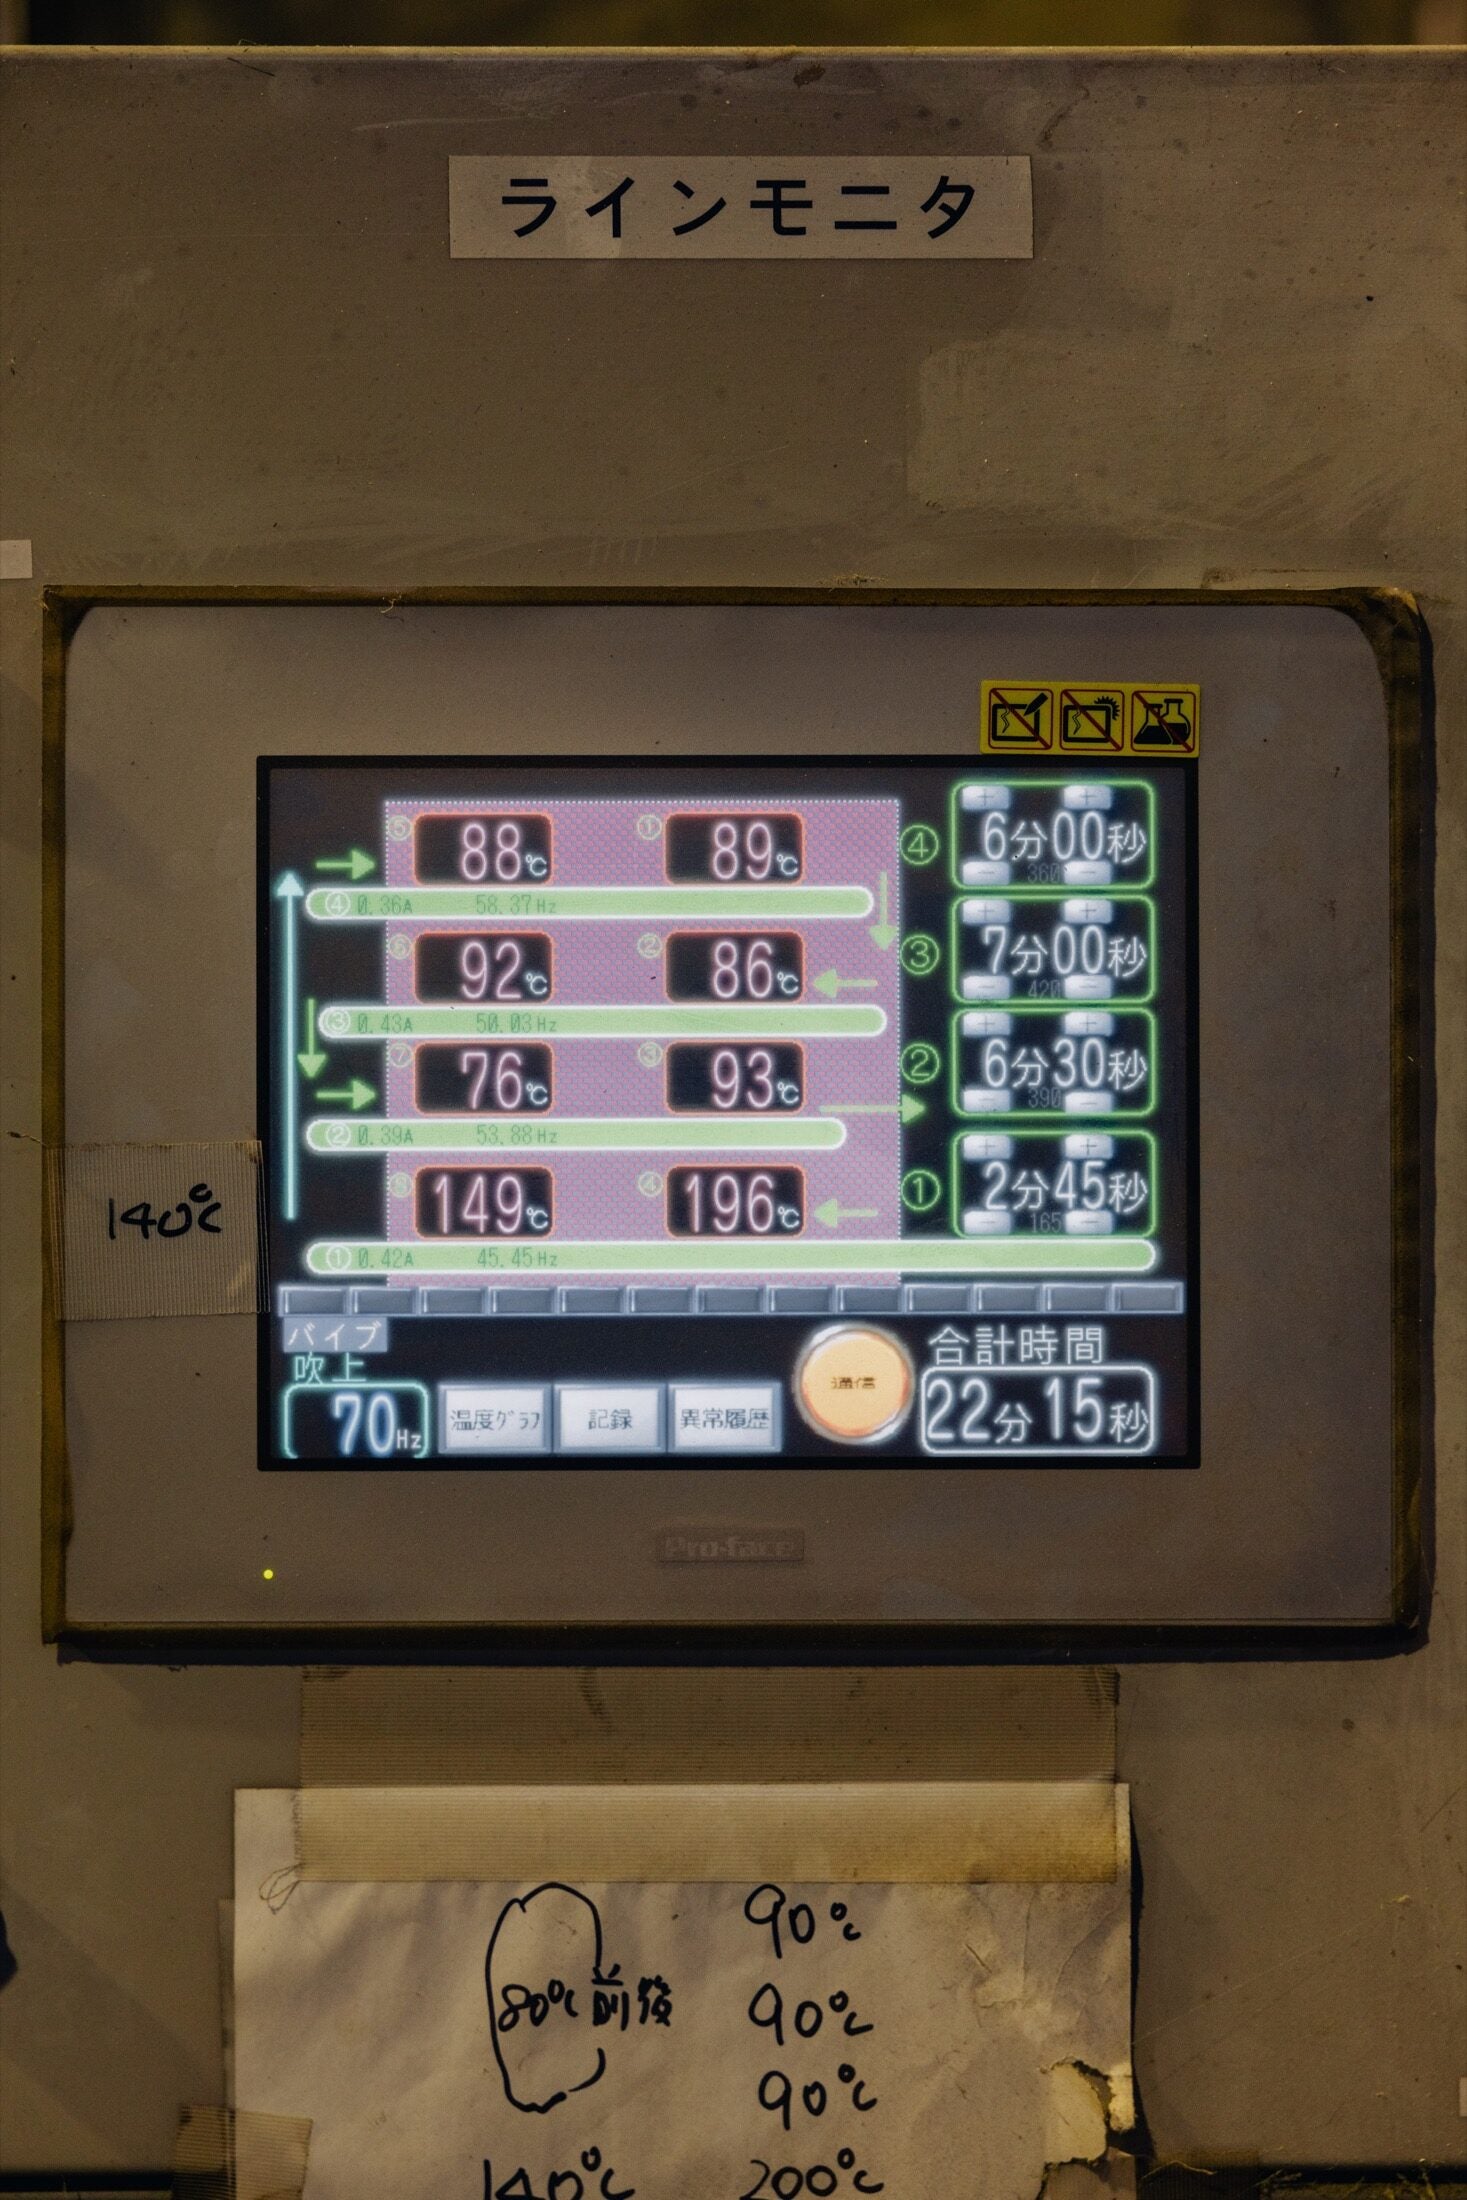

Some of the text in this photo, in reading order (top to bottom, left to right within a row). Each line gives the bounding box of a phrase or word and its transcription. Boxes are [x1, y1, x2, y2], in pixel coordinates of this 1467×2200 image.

[501, 175, 976, 239] ラインモニタ
[462, 823, 549, 880] 88℃
[712, 821, 799, 880] 89℃
[982, 811, 1148, 863] 6分00秒
[462, 941, 549, 999] 92℃
[713, 940, 800, 998] 86℃
[982, 925, 1148, 979] 7分00秒
[462, 1051, 549, 1110] 76℃
[713, 1050, 800, 1109] 93℃
[983, 1037, 1148, 1090] 6分30秒
[434, 1174, 549, 1235] 149℃
[685, 1173, 801, 1233] 196℃
[983, 1160, 1149, 1214] 2分45秒
[287, 1319, 383, 1351] バイブ
[928, 1324, 1105, 1367] 合計時間
[294, 1351, 368, 1384] 吹上
[587, 1408, 633, 1431] 記録
[679, 1407, 770, 1431] 異常履歴
